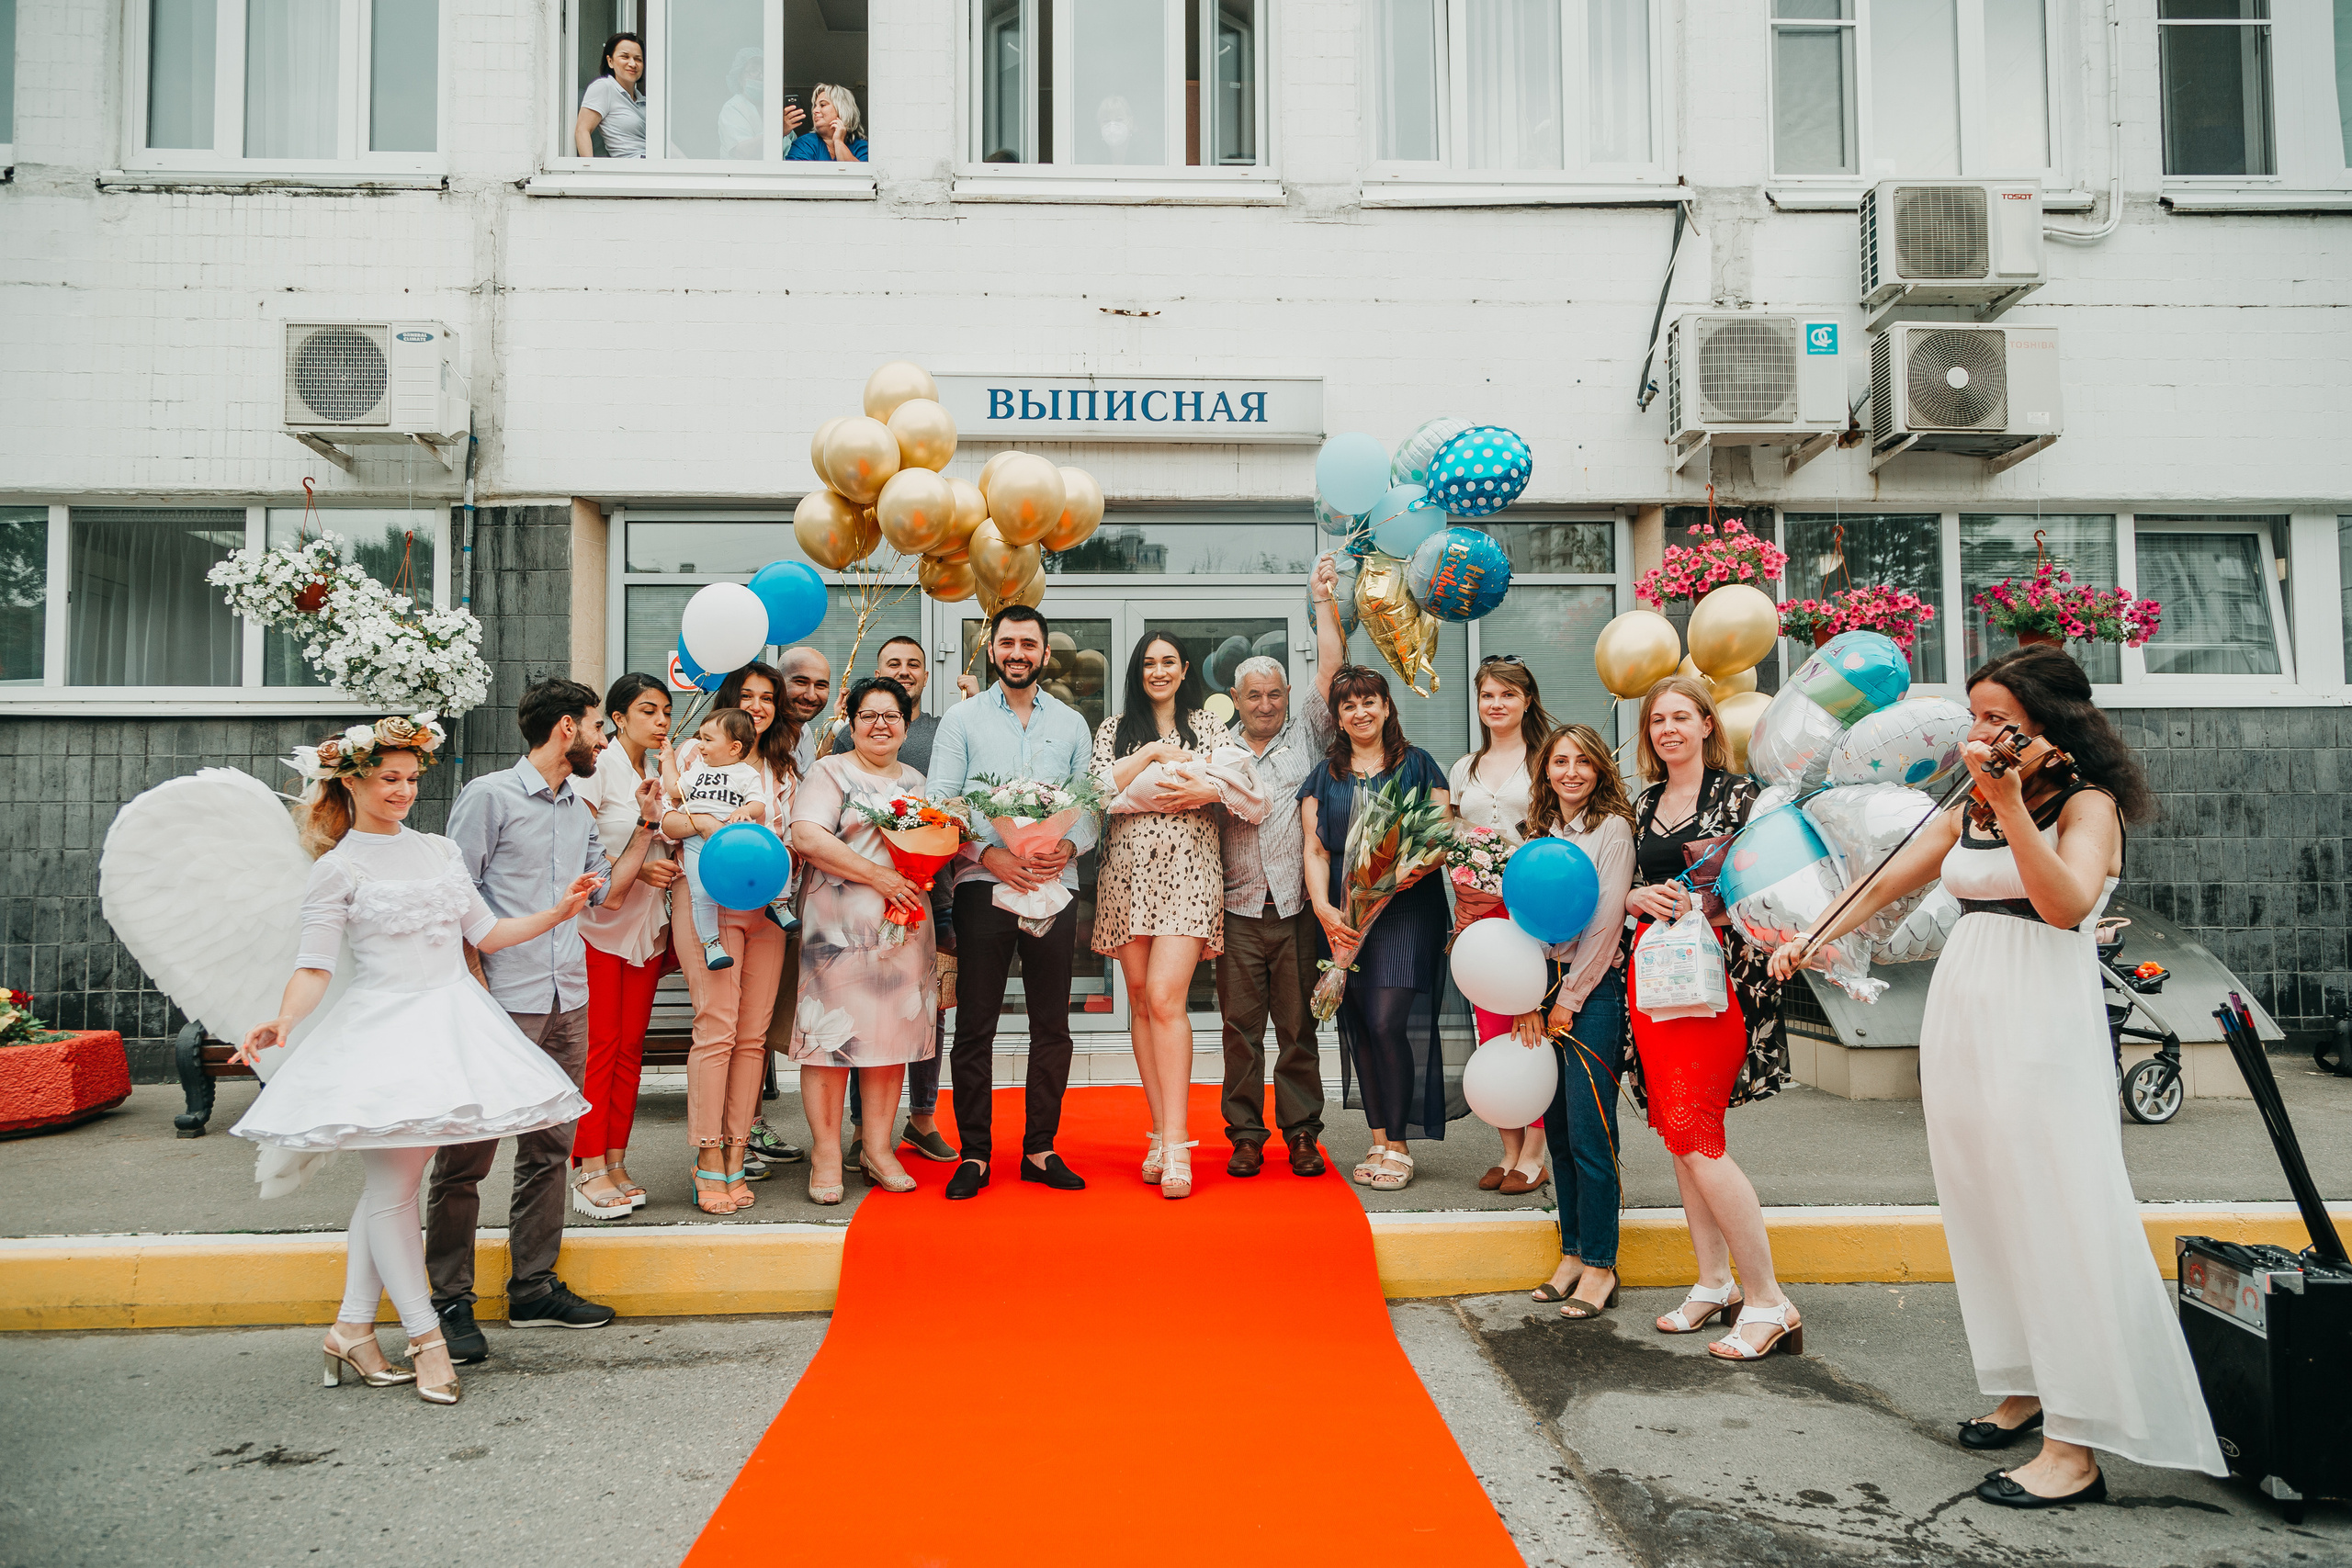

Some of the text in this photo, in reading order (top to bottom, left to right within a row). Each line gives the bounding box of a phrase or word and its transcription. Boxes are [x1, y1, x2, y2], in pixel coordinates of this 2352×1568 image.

[2009, 341, 2055, 349] TOSHIBA
[987, 388, 1268, 423] ВЫПИСНАЯ
[1829, 645, 1847, 658] A
[1795, 659, 1829, 686] OY
[695, 773, 729, 786] BEST
[685, 786, 744, 807] ROTHER
